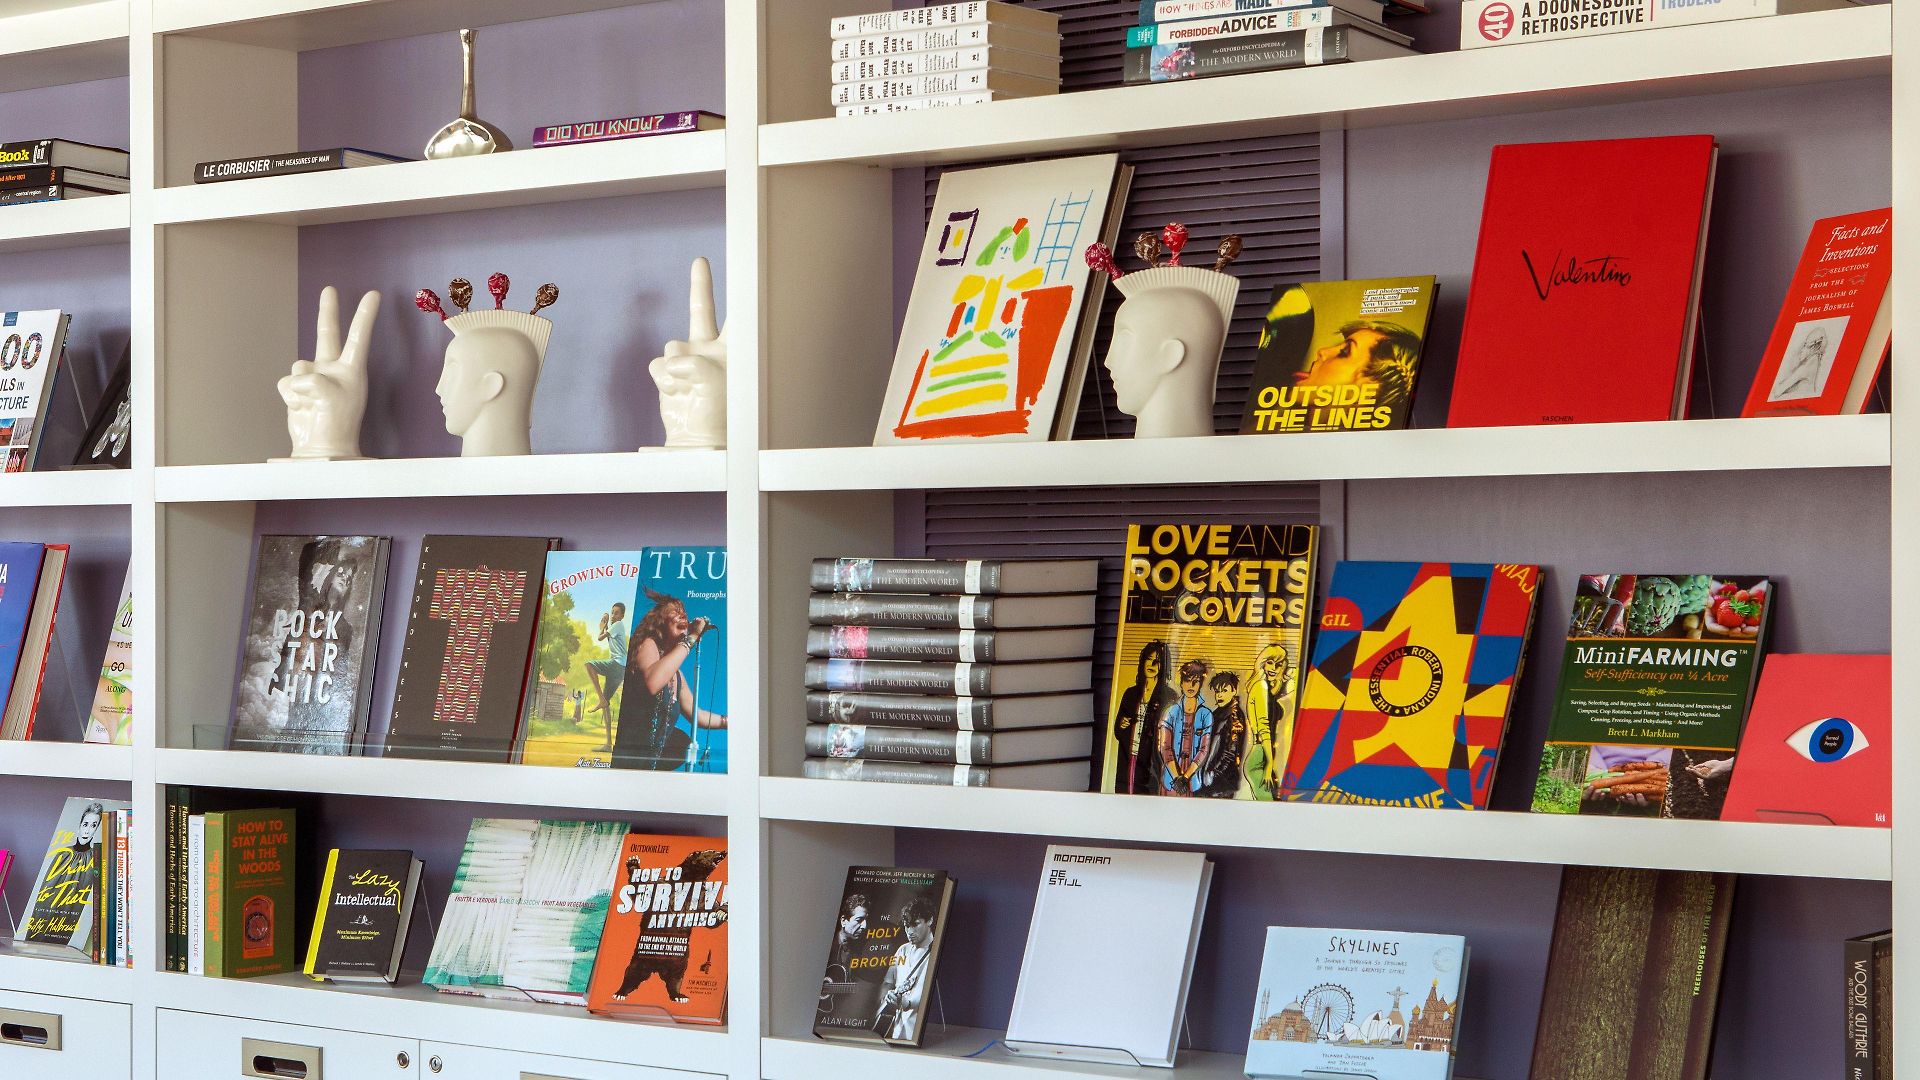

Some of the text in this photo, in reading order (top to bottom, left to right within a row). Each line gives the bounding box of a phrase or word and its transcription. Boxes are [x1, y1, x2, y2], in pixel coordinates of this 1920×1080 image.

[1522, 3, 1531, 18] A
[1170, 26, 1220, 39] FORBIDDEN
[1220, 15, 1277, 33] ADVICE
[1521, 8, 1644, 35] RETROSPECTIVE
[1200, 49, 1297, 67] THE MODERN WORLD
[546, 116, 664, 141] DID YOU KNOW?
[203, 159, 270, 177] LE CORBUSIER
[285, 157, 311, 166] MEASURES
[312, 156, 319, 164] OF
[1825, 219, 1888, 246] Facts and
[1819, 242, 1879, 262] Inventions
[1522, 249, 1631, 300] Valentino
[1829, 262, 1870, 273] SELECTIONS
[1810, 278, 1845, 289] FROM THE
[1804, 290, 1846, 303] JOURNALISM
[17, 382, 24, 390] IN
[1257, 384, 1379, 408] OUTSIDE
[1254, 406, 1391, 431] THE LINES
[1128, 524, 1312, 555] LOVE AND
[550, 563, 639, 595] GROWING UP
[930, 578, 958, 586] WORLD
[1128, 558, 1308, 594] ROCKETS
[687, 590, 726, 599] Photographs
[873, 612, 952, 621] THE MODERN WORLD
[1178, 595, 1304, 624] COVERS
[1322, 613, 1351, 627] GIL
[270, 641, 338, 672] STAR
[872, 645, 953, 655] THE MODERN WORLD
[111, 662, 125, 672] GO
[1370, 647, 1442, 715] THE ESSENTIAL ROBERT INDIANA
[1584, 668, 1667, 682] Self-Sufficiency
[1701, 671, 1729, 682] Acre
[105, 685, 126, 694] ALONG
[266, 672, 334, 704] CHIC
[869, 678, 949, 688] THE MODERN WORLD
[870, 711, 951, 722] THE MODERN WORLD
[1608, 727, 1680, 738] Brett L. Markham
[887, 745, 920, 754] MODERN
[922, 747, 949, 755] WORLD
[237, 820, 283, 833] HOW TO
[117, 838, 126, 848] 13
[232, 833, 288, 848] STAY ALIVE
[243, 848, 277, 860] IN THE
[1053, 854, 1111, 864] MONDRIAN
[239, 861, 281, 874] WOODS
[631, 867, 683, 883] HOW TO
[1049, 878, 1082, 887] STIJL
[37, 880, 93, 908] to That
[335, 893, 397, 906] Intellectual
[648, 912, 717, 928] ANYTHING
[866, 927, 900, 939] HOLY
[1328, 936, 1400, 956] SKYLINES
[1693, 946, 1706, 996] TREEHOUSES
[1702, 934, 1708, 942] OF
[1707, 885, 1716, 912] WORLD
[850, 955, 907, 969] BROKEN
[1855, 960, 1868, 1058] WOODY GUTHRIE
[821, 1017, 867, 1027] ALAN LIGHT
